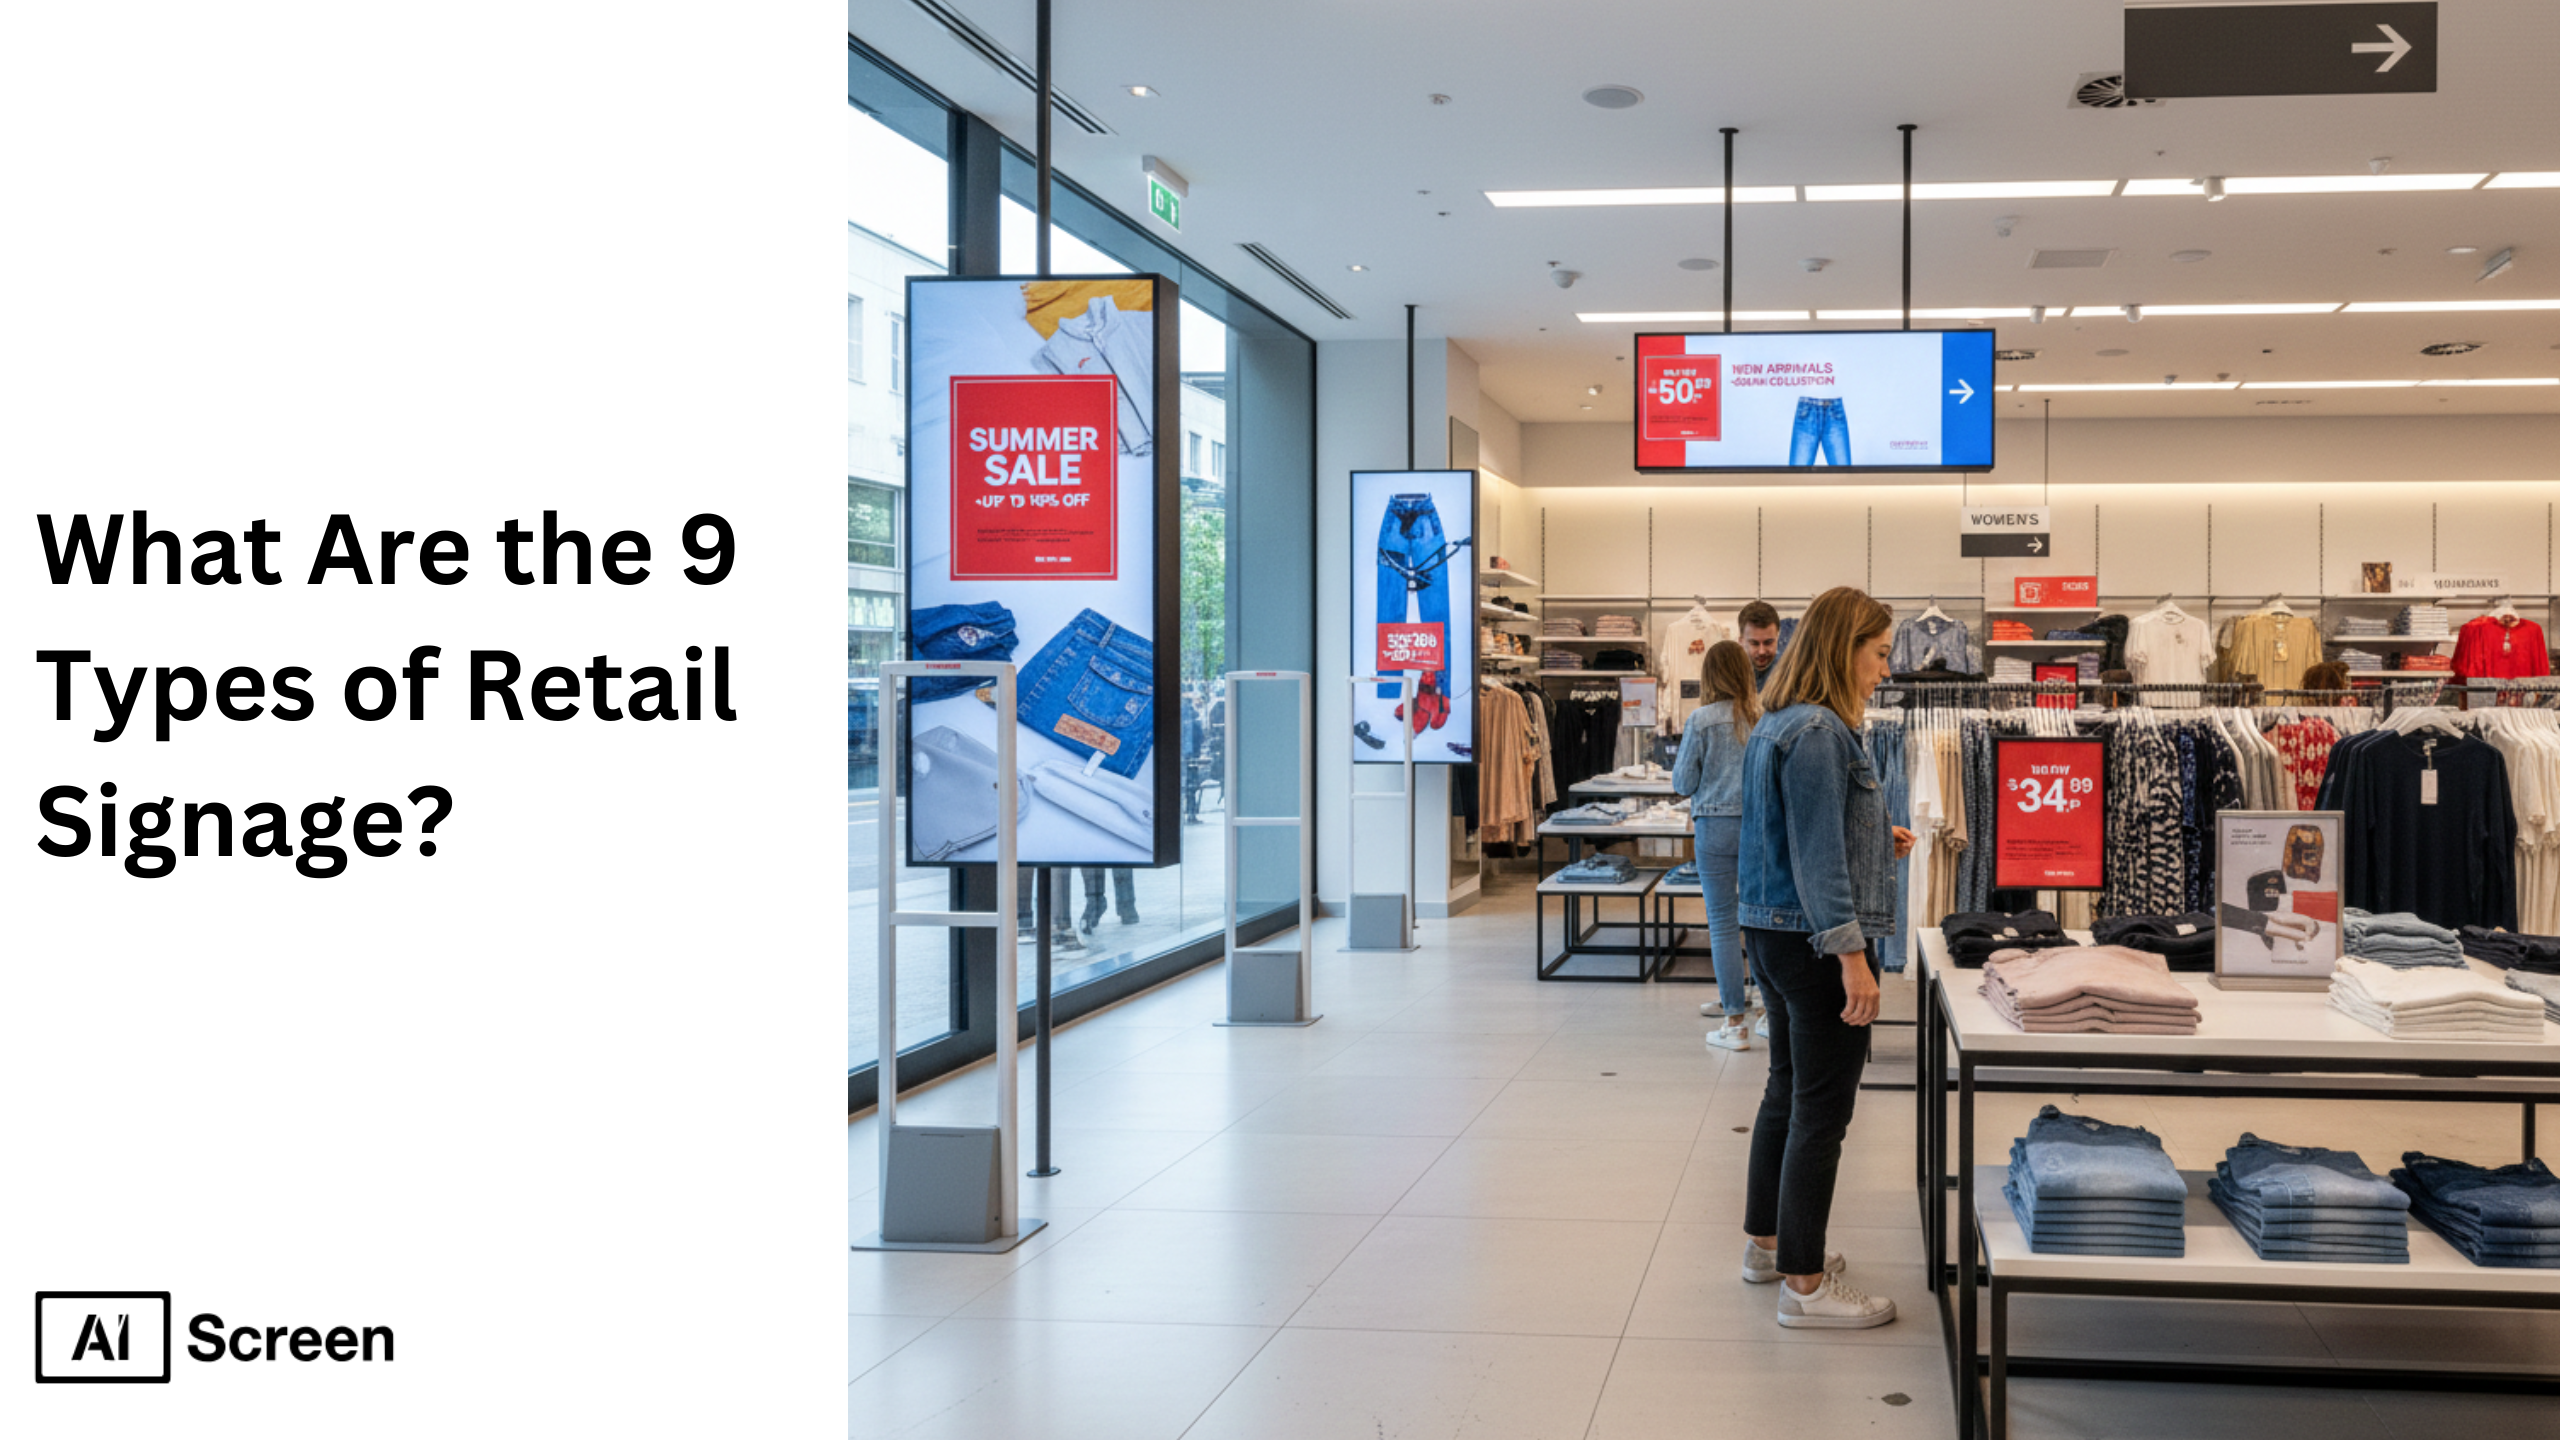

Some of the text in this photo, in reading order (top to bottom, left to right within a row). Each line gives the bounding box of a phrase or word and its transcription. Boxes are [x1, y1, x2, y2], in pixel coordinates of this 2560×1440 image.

[969, 426, 1099, 452] SUMMER
[984, 454, 1082, 486] SALE
[1062, 493, 1091, 507] OFF
